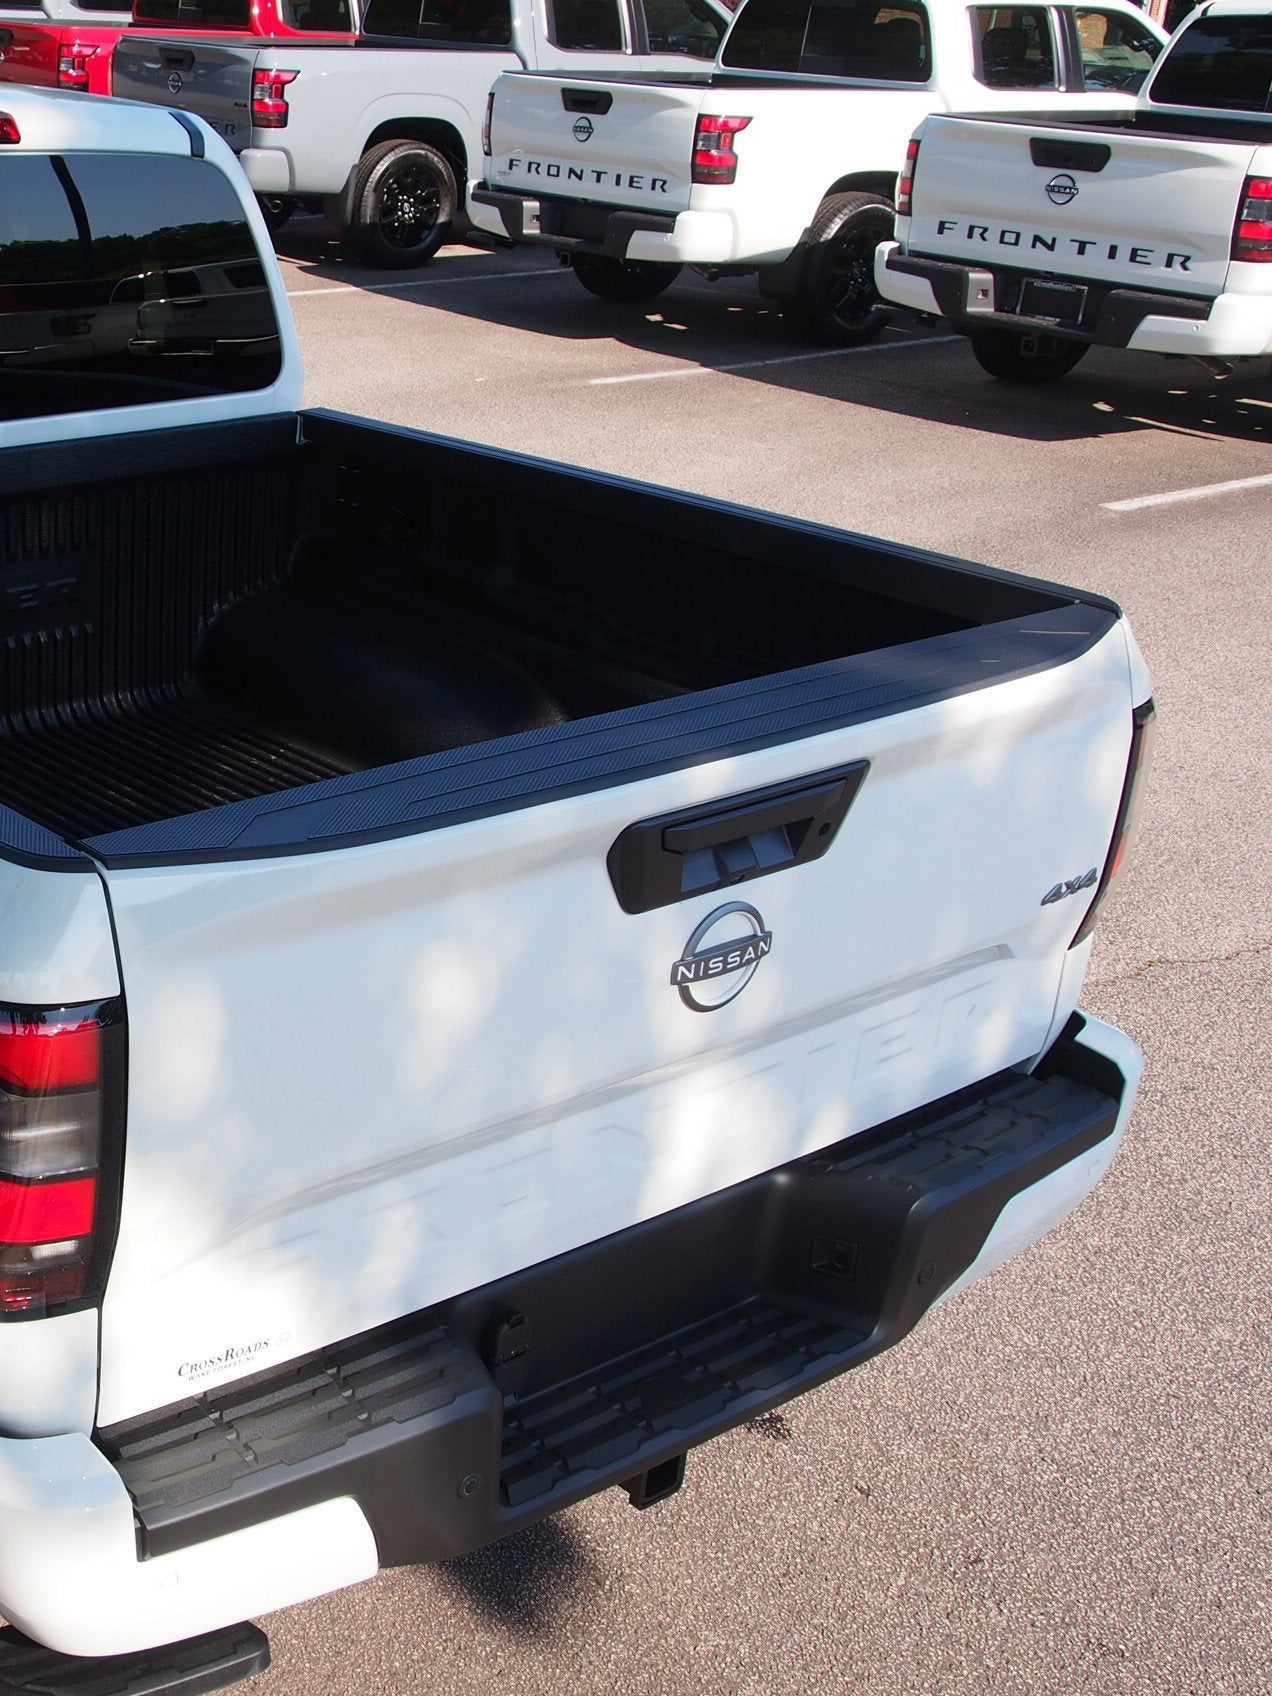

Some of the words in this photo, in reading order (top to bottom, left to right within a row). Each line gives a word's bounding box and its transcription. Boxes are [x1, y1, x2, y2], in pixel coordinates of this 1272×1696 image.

[508, 158, 668, 193] FRONTIER
[1045, 184, 1078, 195] NISSAN
[937, 220, 1193, 272] FRONTIER
[676, 937, 771, 981] NISSAN
